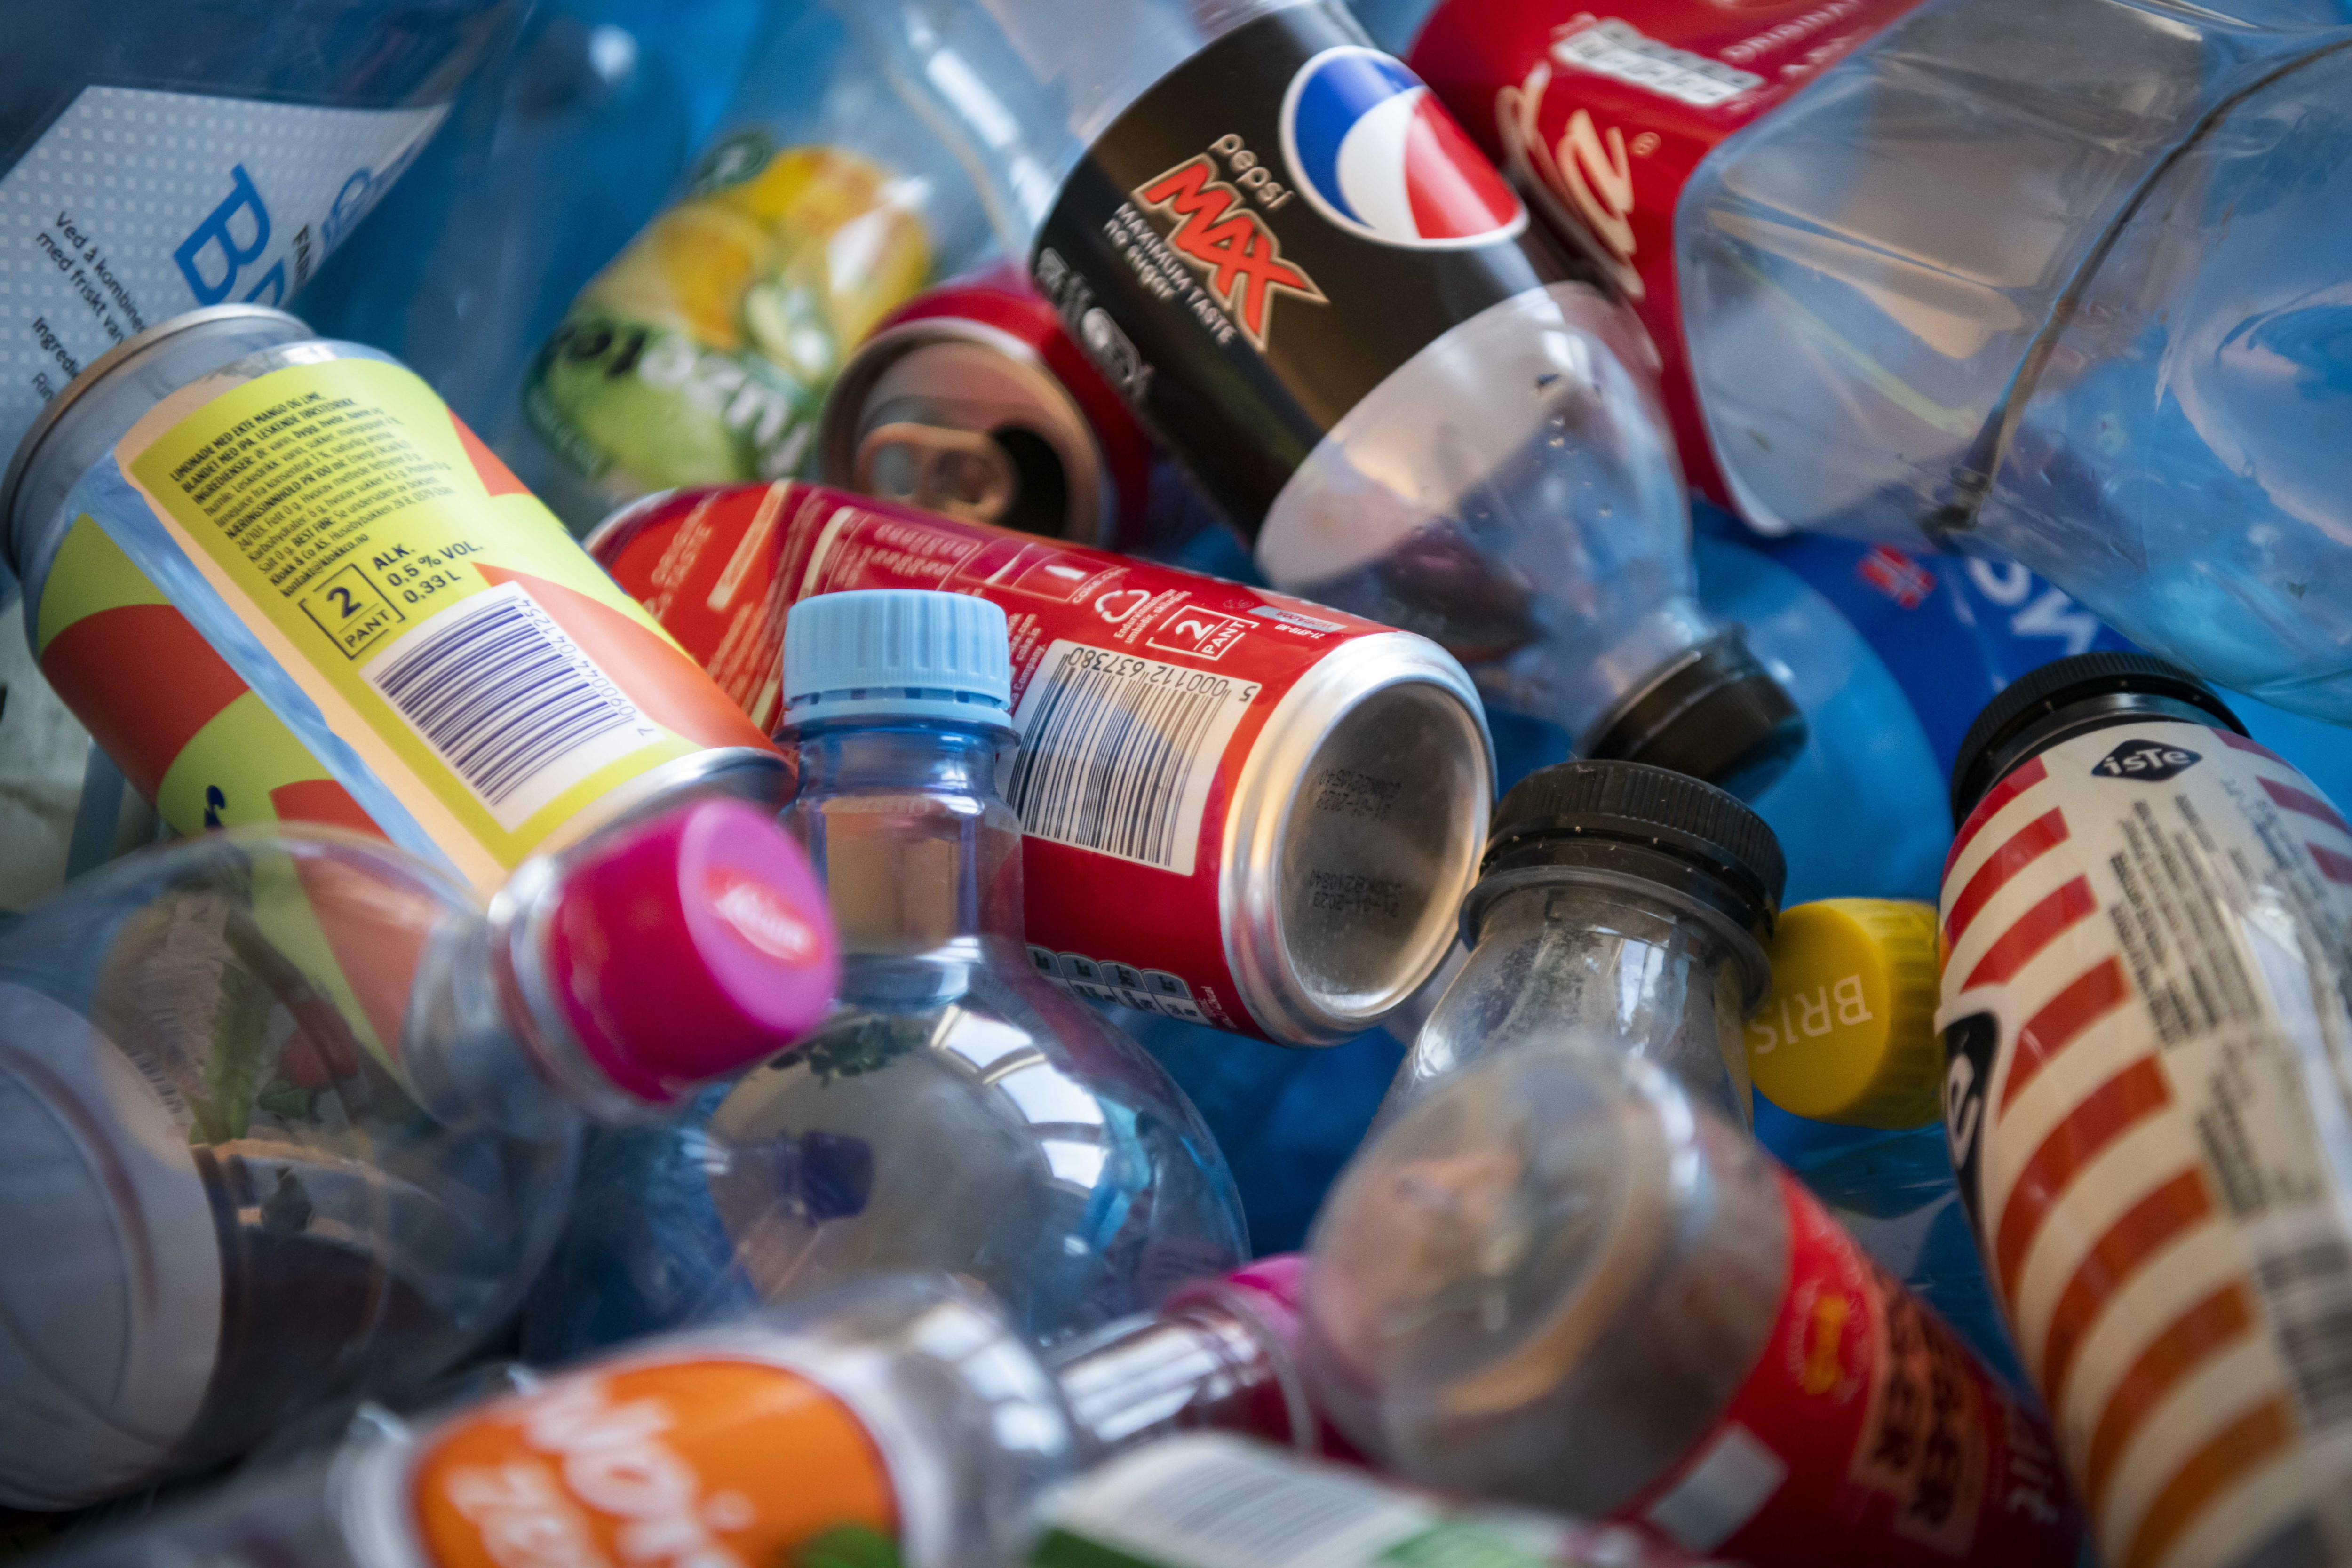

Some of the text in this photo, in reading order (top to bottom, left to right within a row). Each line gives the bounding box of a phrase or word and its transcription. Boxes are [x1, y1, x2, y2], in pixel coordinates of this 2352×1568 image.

[1207, 133, 1296, 212] pepsi
[56, 211, 90, 250] Ved
[83, 247, 98, 263] å
[1115, 202, 1193, 293] MAXIMUM
[1131, 152, 1332, 355] MAX
[36, 232, 76, 272] med
[70, 268, 108, 318] friskt
[170, 445, 215, 482] LIMONADE
[212, 432, 234, 449] MED
[231, 420, 256, 437] EKTE
[253, 404, 287, 421] MANGO
[286, 398, 302, 409] OG
[181, 462, 218, 493] BLANDET
[217, 447, 239, 464] MED
[255, 415, 301, 441] LESKENDE
[224, 481, 302, 540] NÆRINGSINNHOLD
[300, 474, 316, 486] PR
[313, 465, 333, 478] 100
[264, 511, 286, 528] Fett
[300, 483, 333, 503] Hvorav
[324, 489, 356, 507] hvorav
[257, 557, 278, 574] Salt
[291, 528, 315, 548] BEST
[333, 510, 349, 520] Se
[347, 488, 396, 514] undersiden
[269, 564, 297, 586] Klokk
[294, 556, 305, 566] &
[301, 549, 317, 560] Co
[279, 534, 369, 598] kontakt@klokkco.no
[373, 544, 414, 571] ALK.
[387, 541, 483, 587] 0,5 % VOL.
[327, 587, 362, 619] 2
[403, 570, 461, 604] 0,33 L
[344, 609, 389, 648] PANT
[1016, 627, 1041, 660] coke.is
[1201, 621, 1246, 654] PANT
[1013, 643, 1049, 692] Company.
[1067, 647, 1257, 702] 5 000112 637380
[1749, 974, 1873, 1055] BRIS
